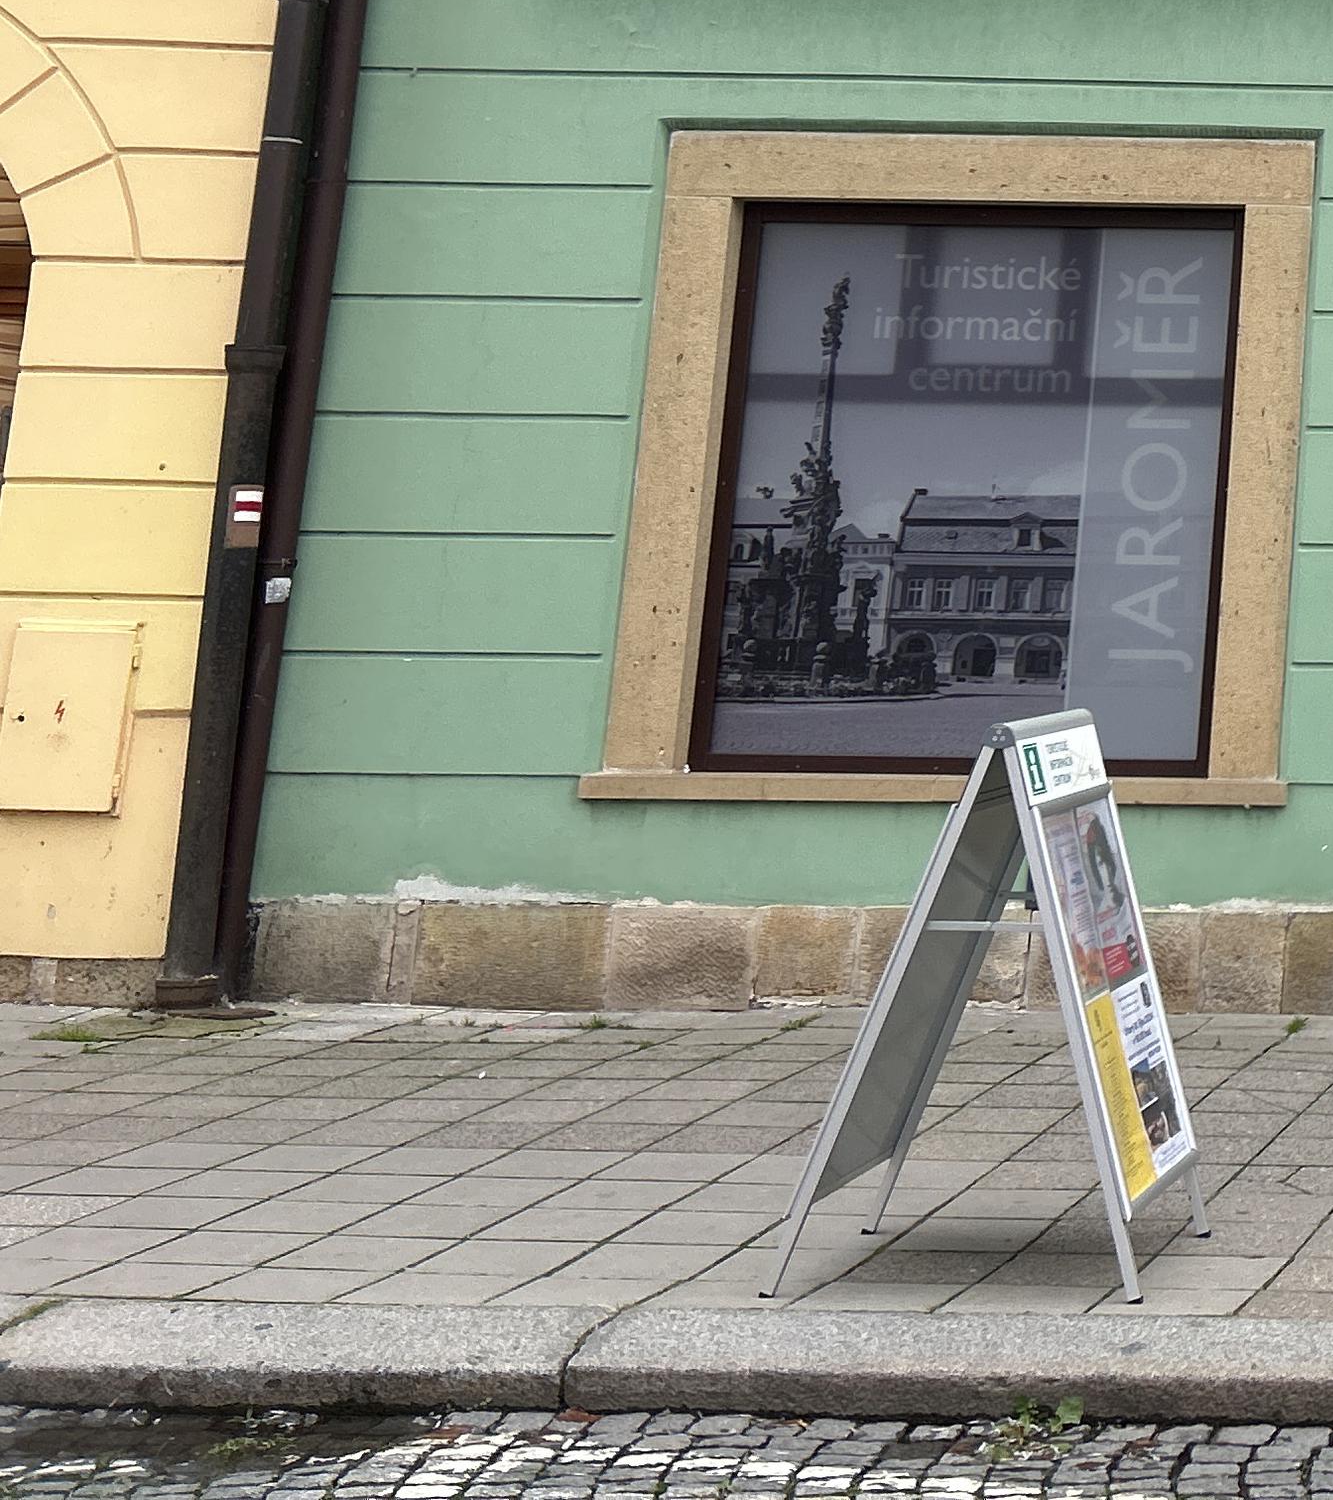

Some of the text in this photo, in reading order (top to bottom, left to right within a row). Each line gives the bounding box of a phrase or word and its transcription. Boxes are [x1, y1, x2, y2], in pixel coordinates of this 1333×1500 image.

[895, 253, 1082, 294] Turistické
[873, 307, 1077, 344] informační
[908, 364, 1073, 395] centrum
[1108, 257, 1204, 673] JAROMĚŘ
